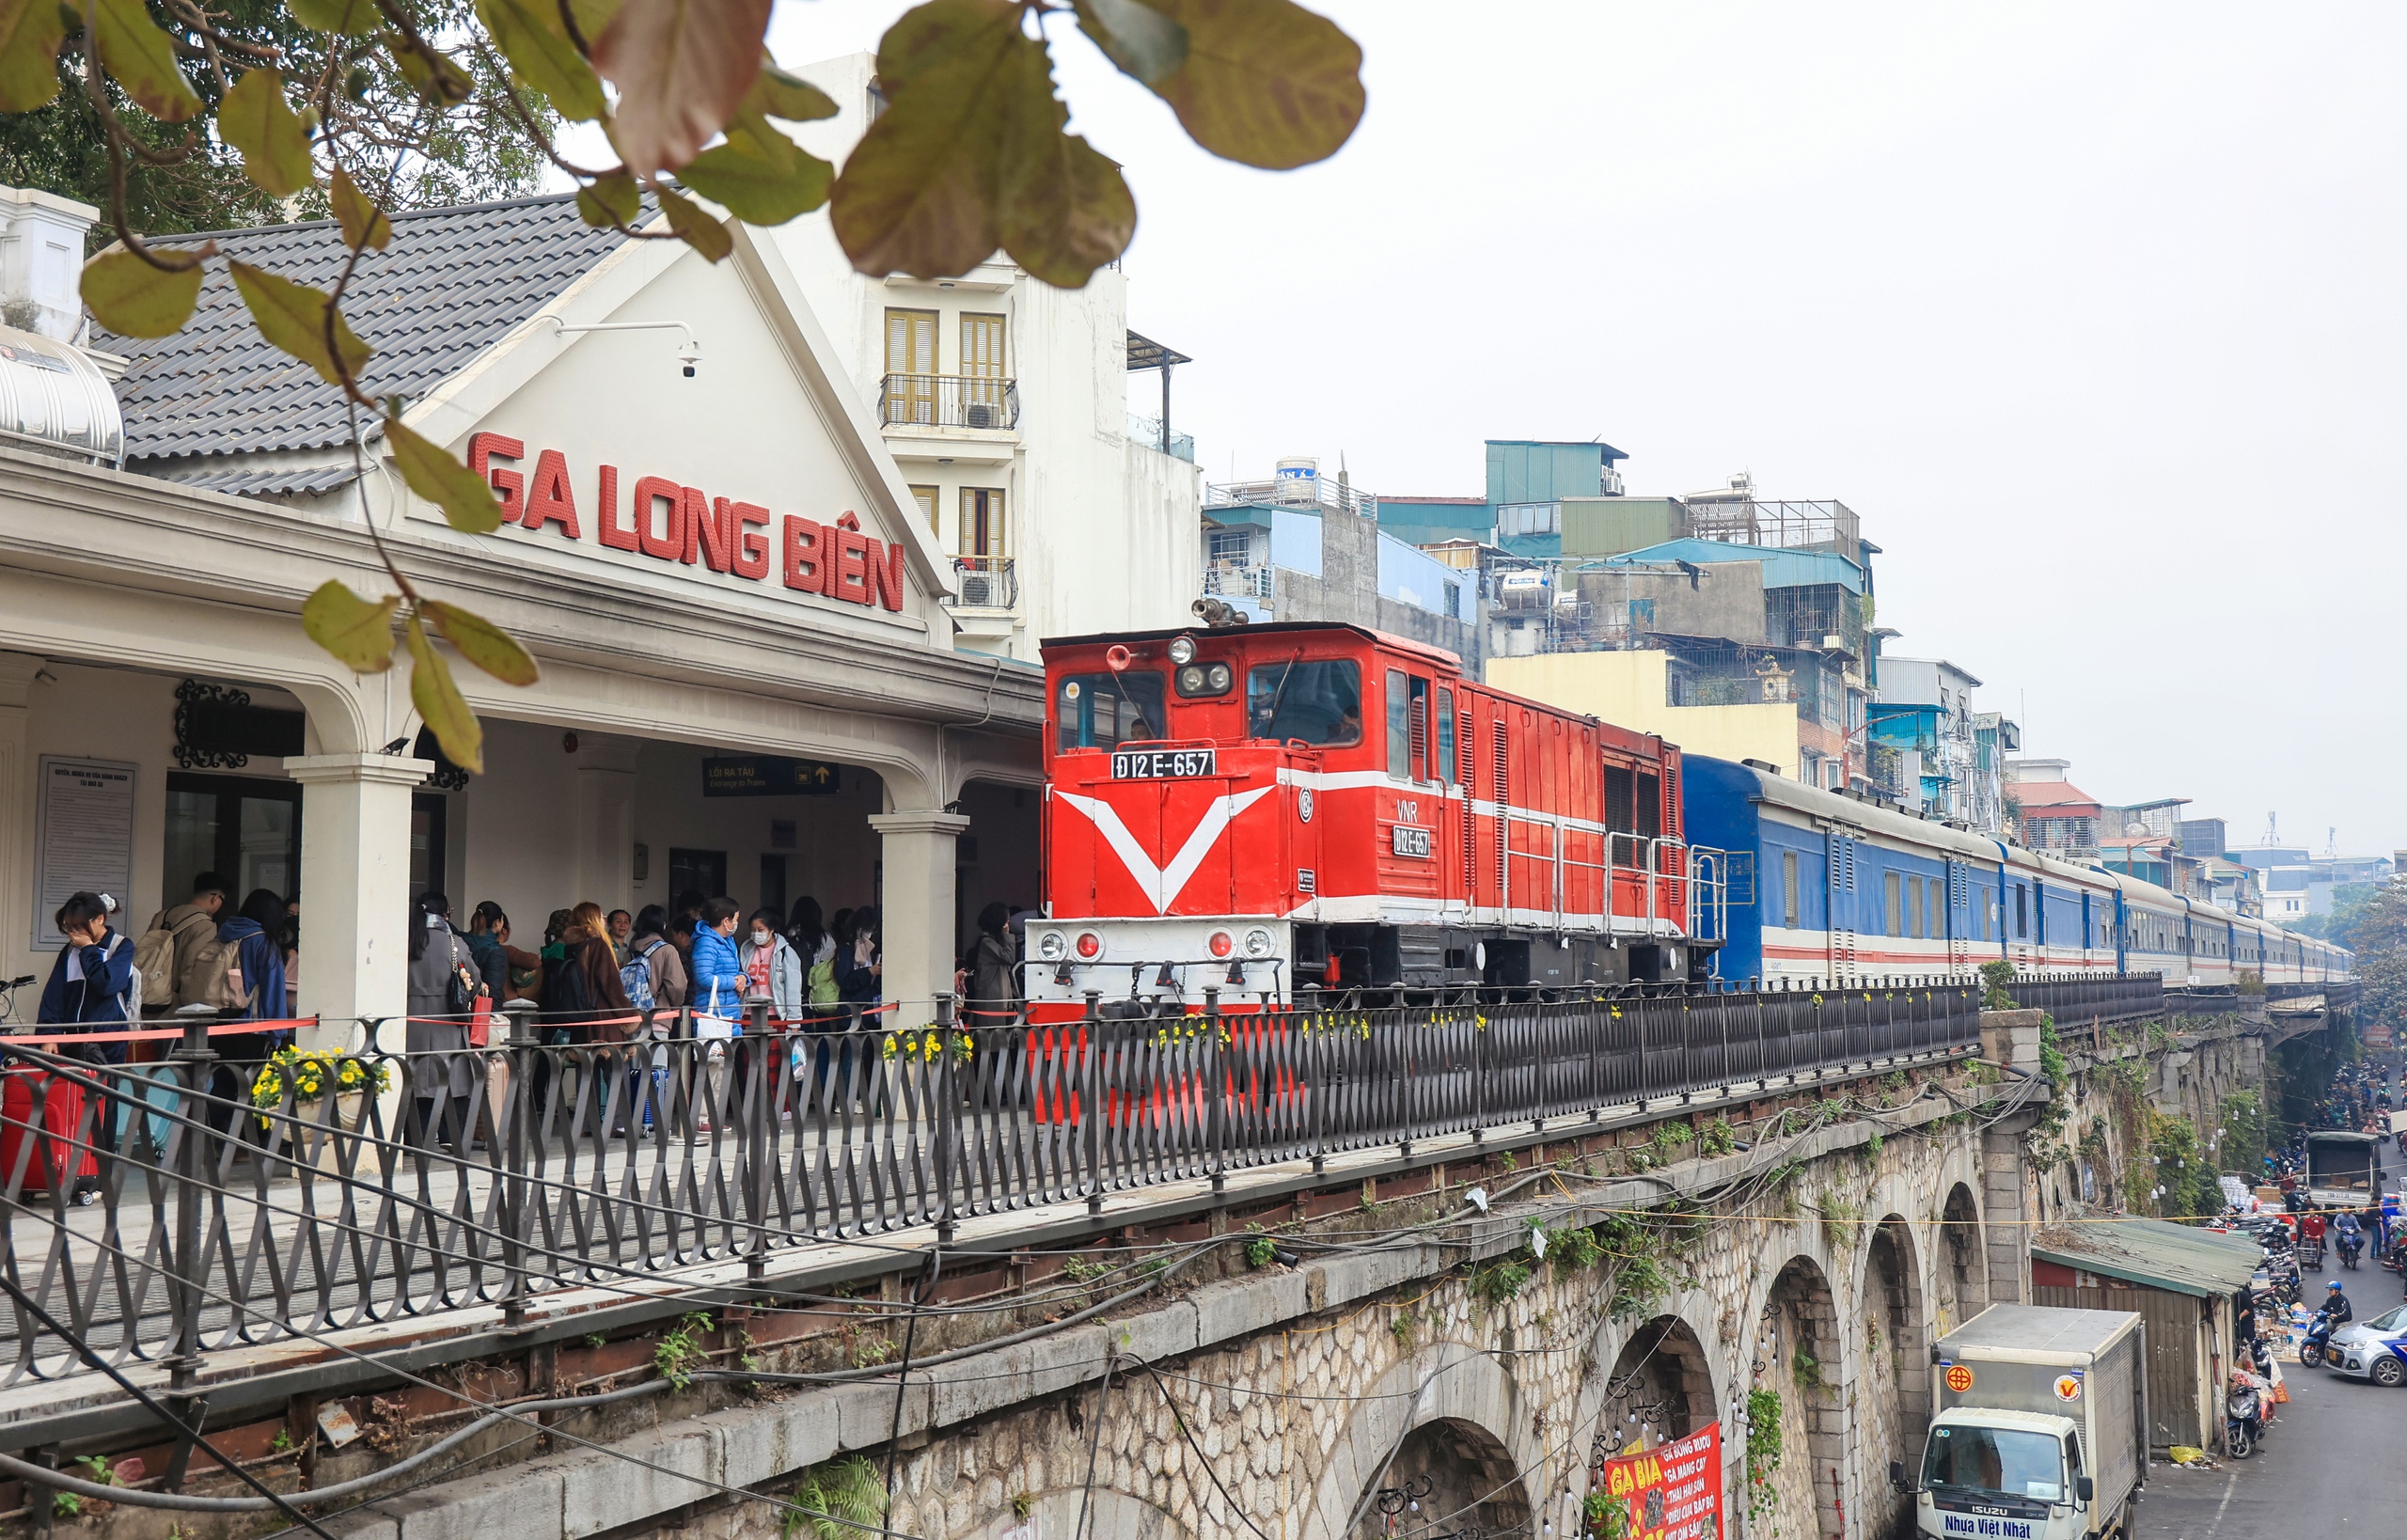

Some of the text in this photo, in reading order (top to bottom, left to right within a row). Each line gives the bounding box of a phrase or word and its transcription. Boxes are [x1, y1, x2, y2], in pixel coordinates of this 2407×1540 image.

[467, 432, 904, 612] GA LONG BIÊN
[709, 765, 754, 778] LỐI RA TÀU
[710, 779, 737, 788] Entrance
[747, 778, 766, 787] Trains
[1396, 799, 1418, 823] VNR
[747, 965, 770, 985] 25
[1633, 1454, 1662, 1490] BIA
[1695, 1456, 1707, 1472] CAY
[1681, 1503, 1693, 1519] CUA
[1972, 1505, 2008, 1516] ISUZU
[1944, 1515, 2031, 1540] Nhựa Việt Nhật
